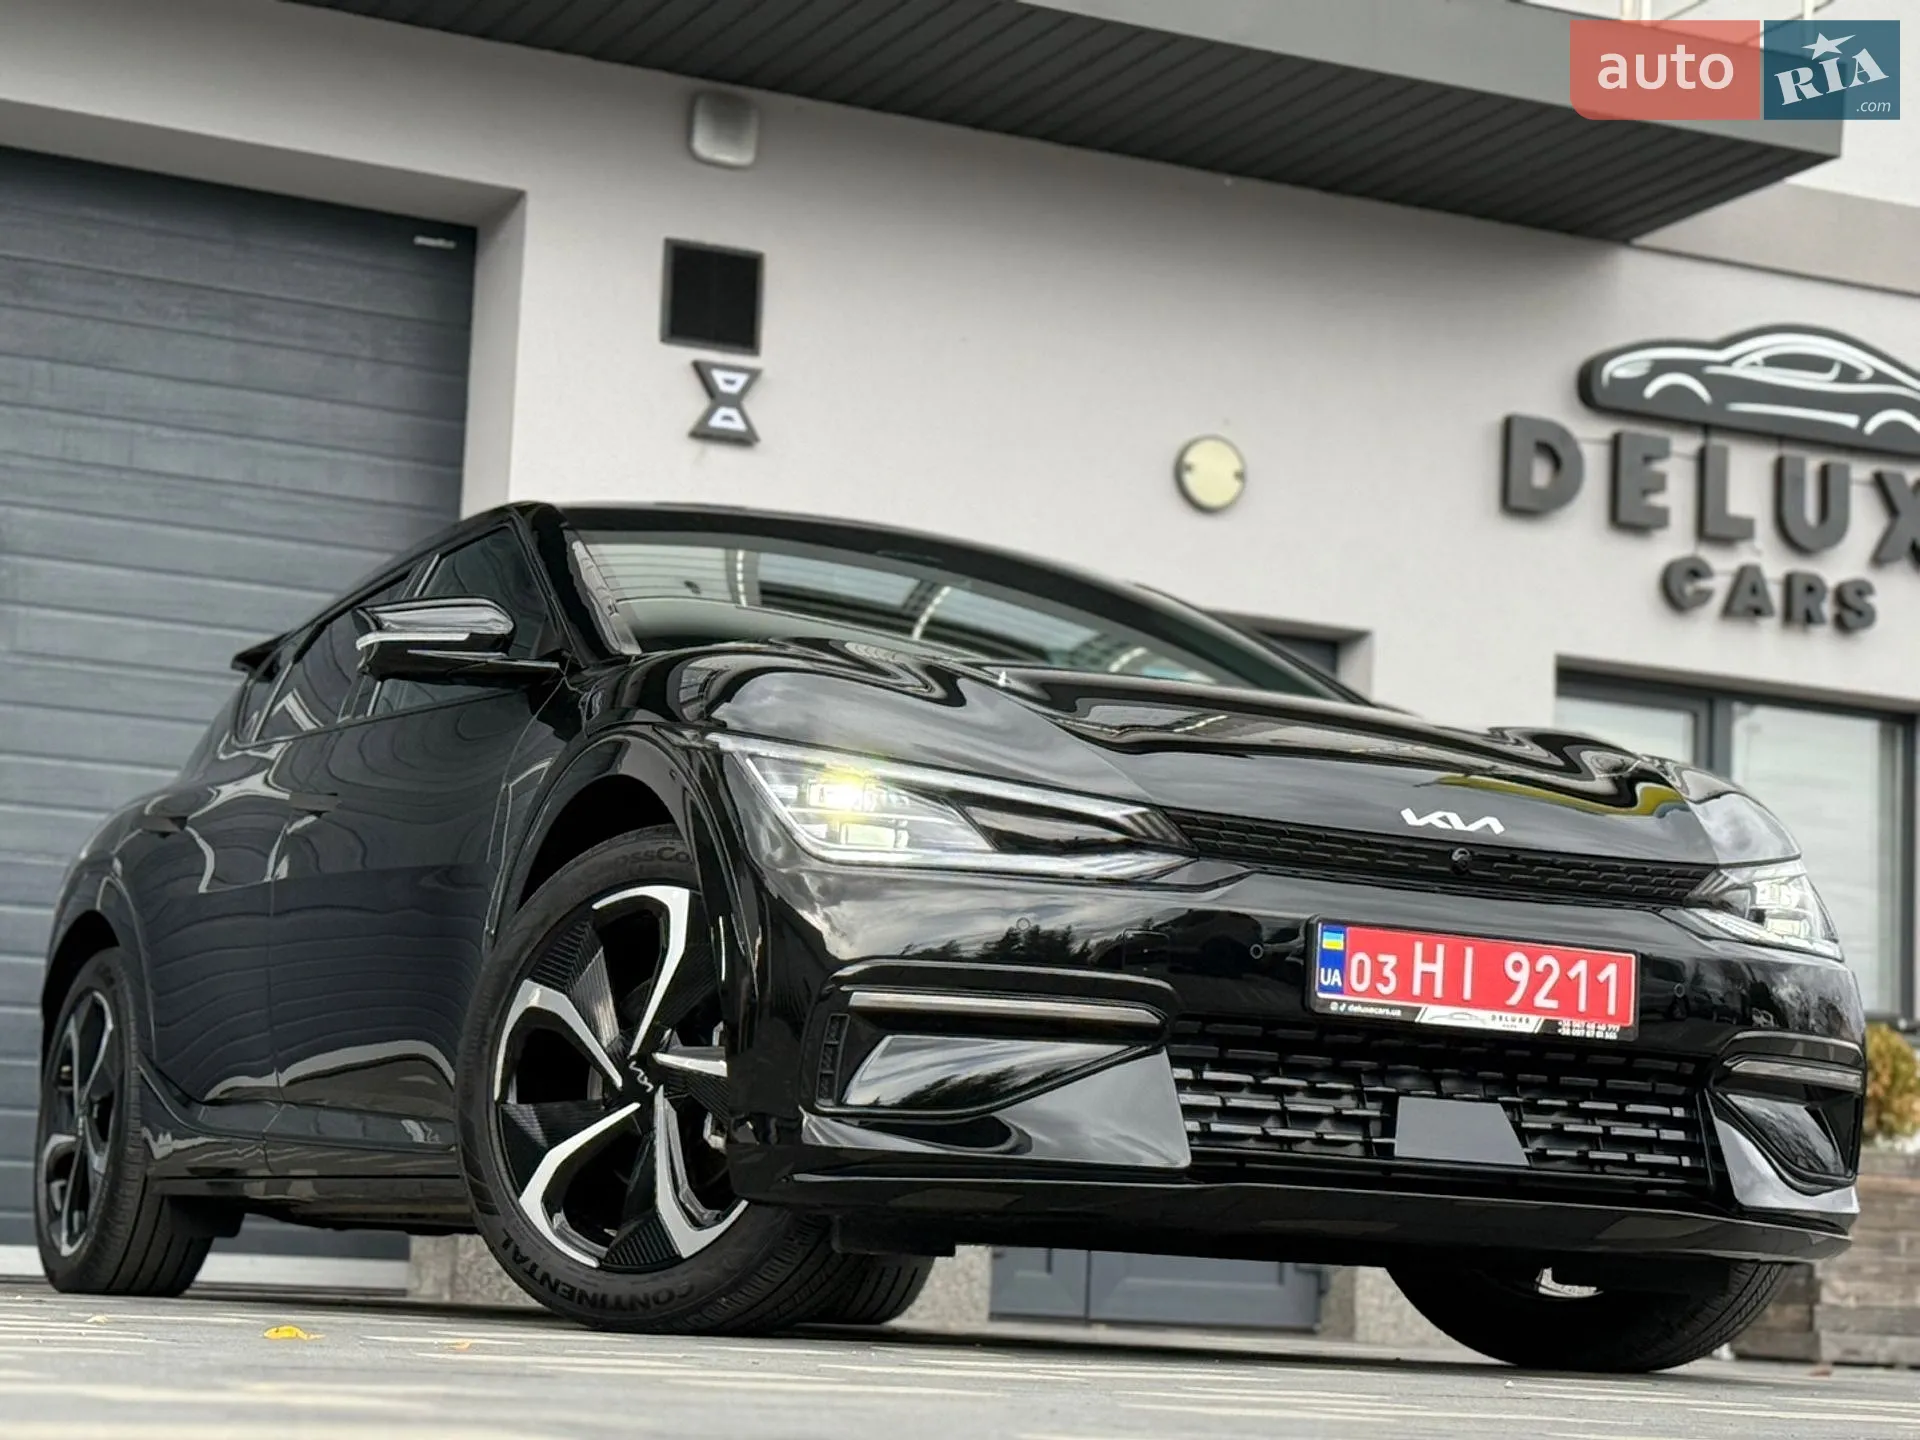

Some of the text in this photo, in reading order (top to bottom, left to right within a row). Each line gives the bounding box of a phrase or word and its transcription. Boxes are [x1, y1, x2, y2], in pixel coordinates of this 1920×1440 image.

[1501, 414, 1920, 569] DELUX
[1661, 554, 1877, 635] CARS
[1400, 807, 1505, 835] KIA
[1320, 968, 1342, 987] UA
[1349, 940, 1618, 1016] 03 HI 9211
[501, 1228, 695, 1312] CONTINENTAL
